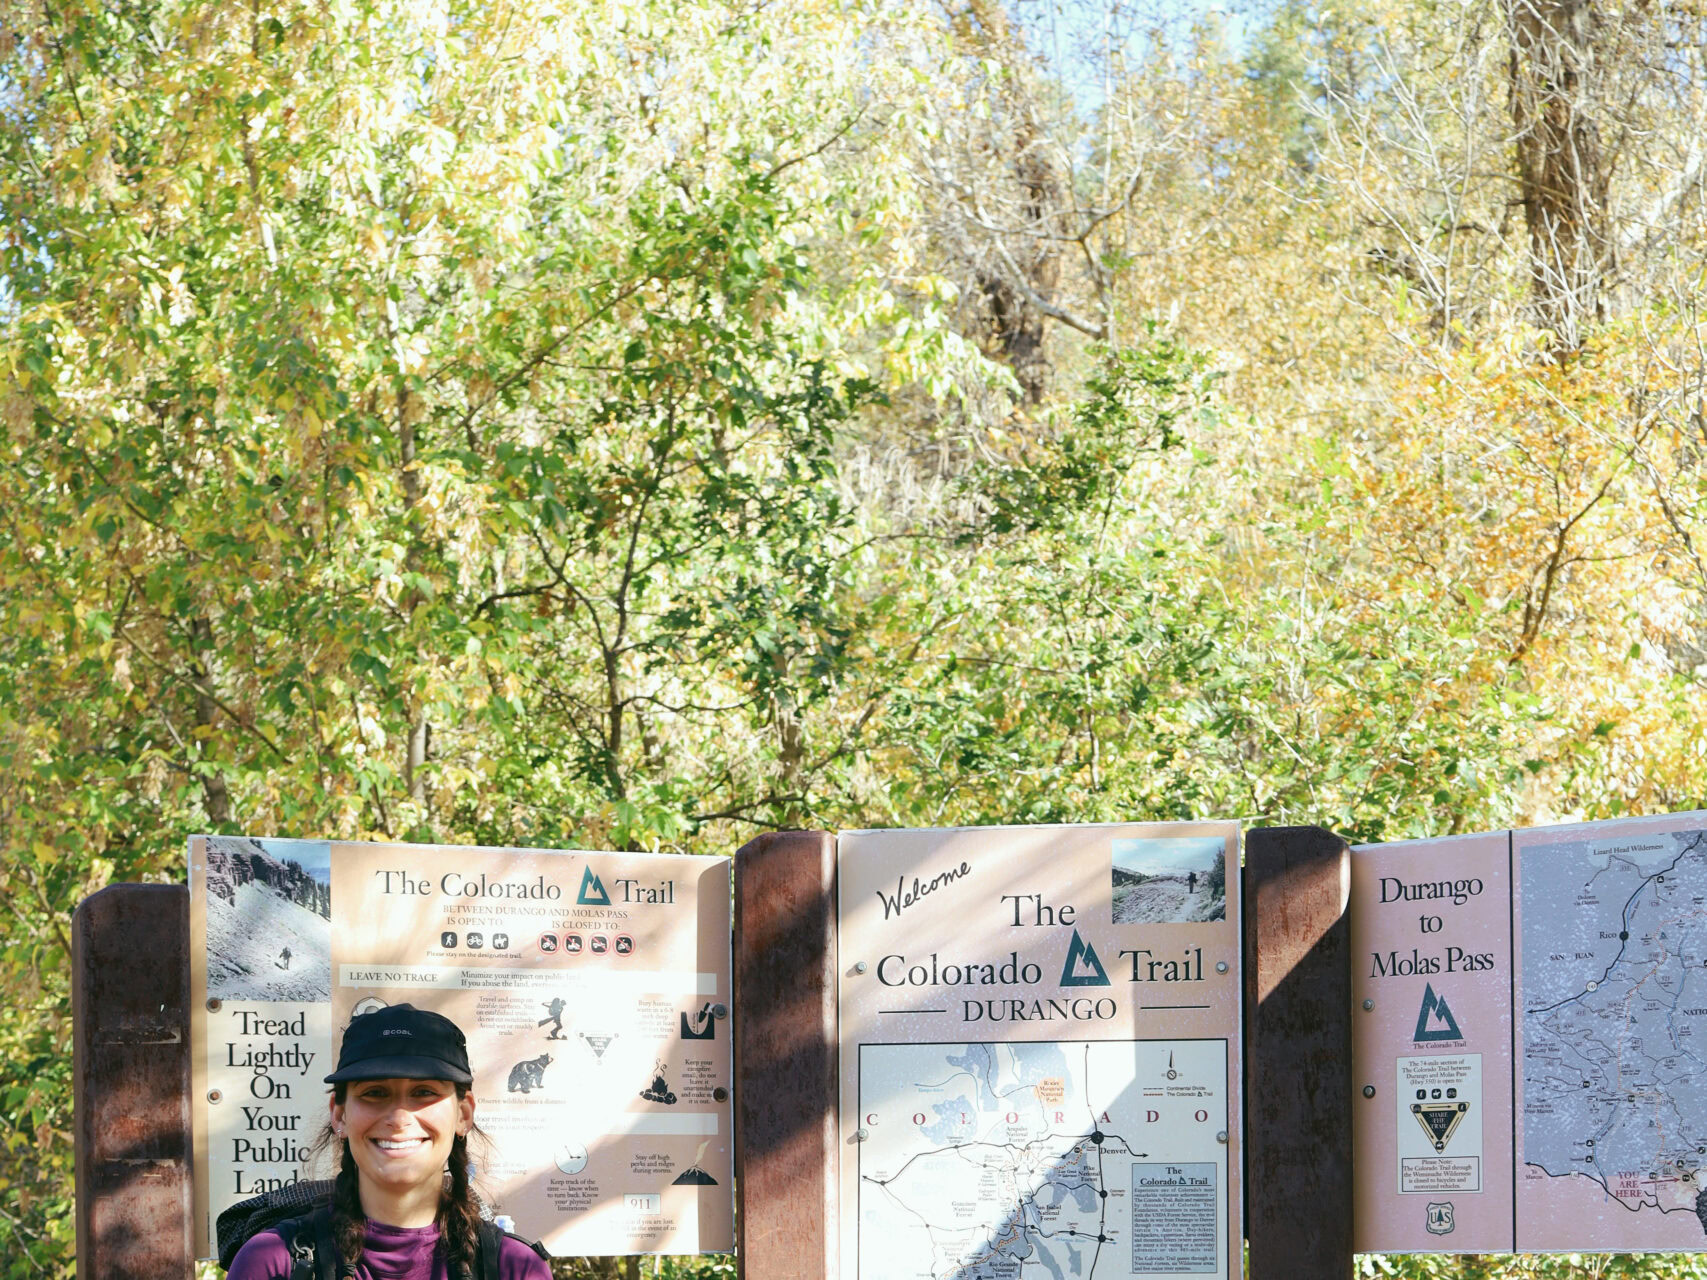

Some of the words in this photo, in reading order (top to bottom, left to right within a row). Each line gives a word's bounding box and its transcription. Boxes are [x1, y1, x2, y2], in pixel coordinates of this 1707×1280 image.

[1613, 846, 1630, 854] Head
[1631, 844, 1664, 852] Wilderness
[375, 870, 432, 896] The
[440, 872, 561, 900] Colorado
[615, 879, 675, 904] Trail
[876, 860, 972, 920] Welcome
[1378, 877, 1484, 906] Durango
[443, 905, 493, 915] BETWEEN
[495, 906, 546, 916] DURANGO
[550, 908, 569, 916] AND
[571, 909, 605, 918] MOLAS
[607, 910, 628, 918] PASS
[1000, 894, 1076, 927] The
[447, 917, 456, 925] IS
[458, 917, 485, 926] OPEN
[552, 920, 560, 928] IS
[563, 921, 601, 930] CLOSED
[1419, 914, 1443, 933] to
[1600, 931, 1617, 939] Rico
[1369, 948, 1440, 978] Molas
[1444, 946, 1495, 973] Pass
[1575, 952, 1594, 960] JUAN
[876, 952, 1042, 987] Colorado
[1119, 948, 1205, 982] Trail
[350, 972, 382, 981] LEAVE
[384, 973, 401, 981] NO
[403, 973, 438, 982] TRACE
[461, 971, 493, 979] Minimize
[511, 973, 533, 981] impact
[962, 998, 1117, 1022] DURANGO
[233, 1011, 306, 1036] Tread
[225, 1043, 315, 1076] Lightly
[250, 1075, 292, 1099] On
[240, 1106, 301, 1131] Your
[232, 1138, 311, 1163] Public
[1165, 1166, 1183, 1175] The
[1618, 1171, 1640, 1179] YOU
[233, 1170, 310, 1195] Land
[1188, 1177, 1208, 1185] Trail
[1620, 1180, 1639, 1188] ARE
[1615, 1190, 1642, 1198] HERE
[630, 1199, 651, 1209] 911
